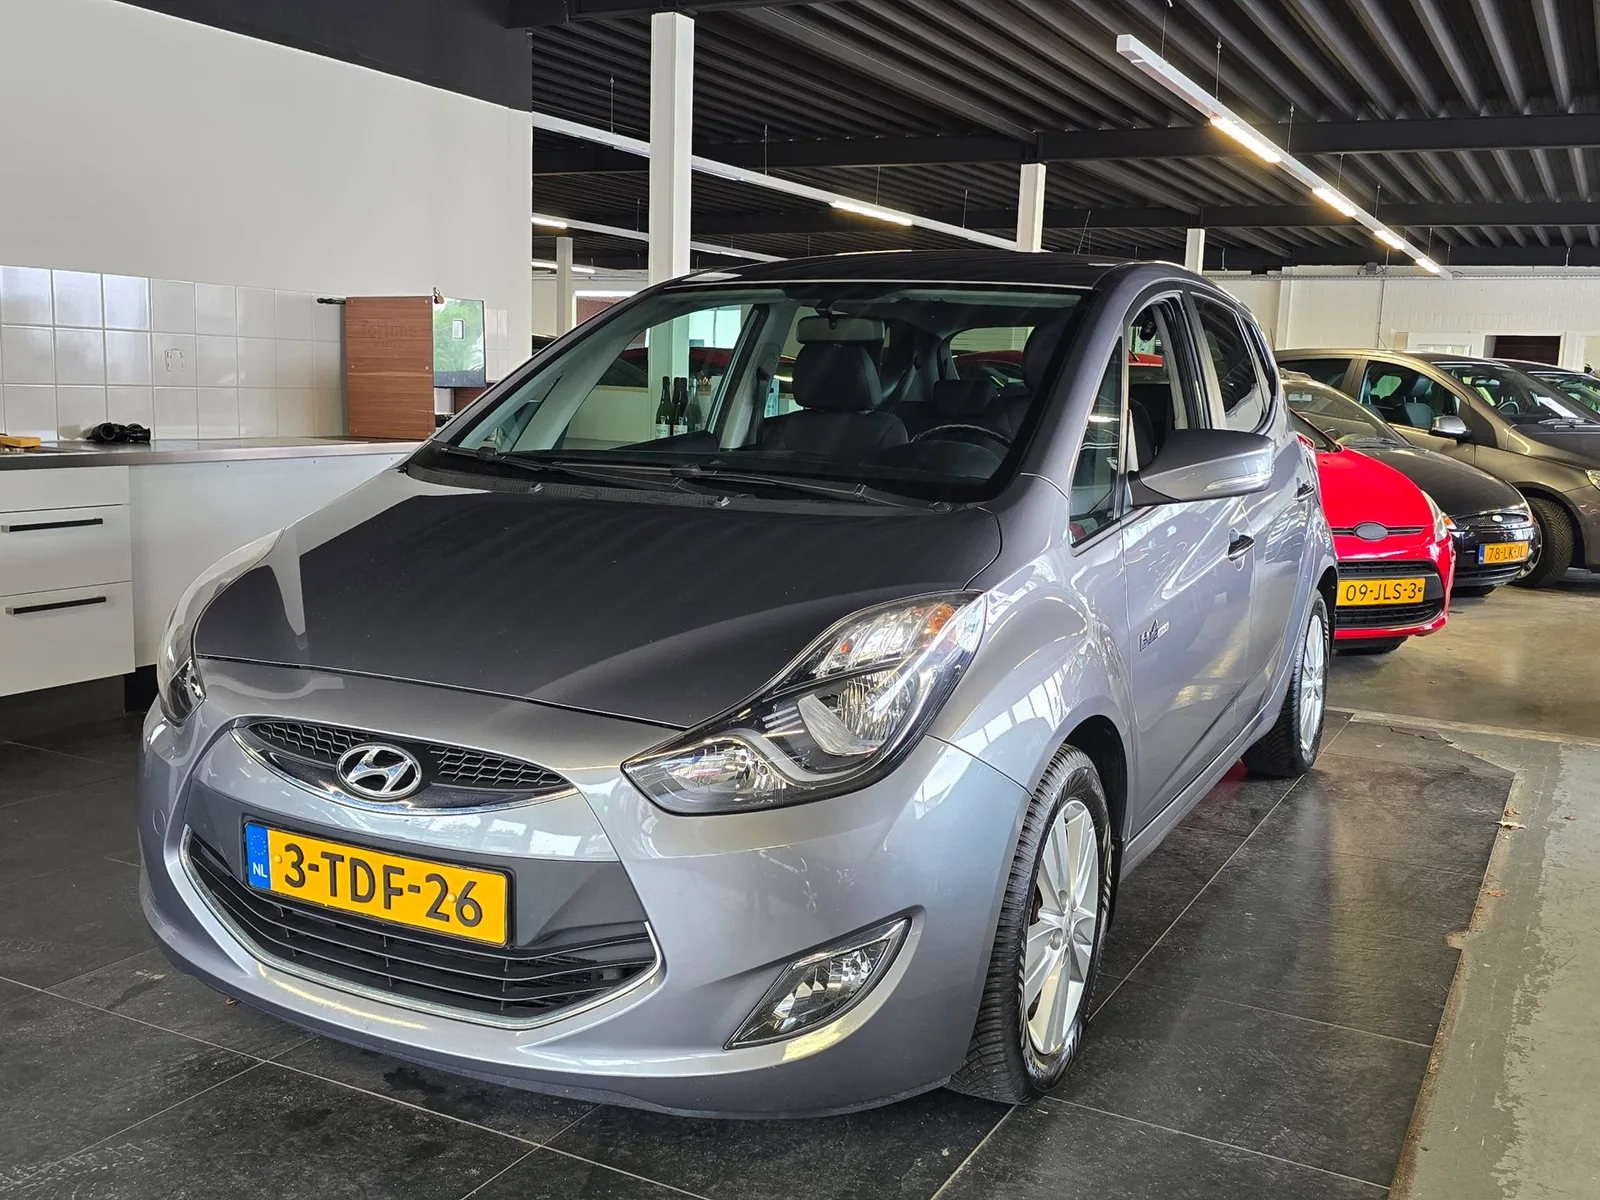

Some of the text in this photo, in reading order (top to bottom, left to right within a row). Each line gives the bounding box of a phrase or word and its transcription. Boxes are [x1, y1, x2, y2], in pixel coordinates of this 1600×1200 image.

[1345, 582, 1417, 602] 09-JLS-3
[252, 862, 268, 879] NL
[284, 843, 483, 928] 3-TDF-26
